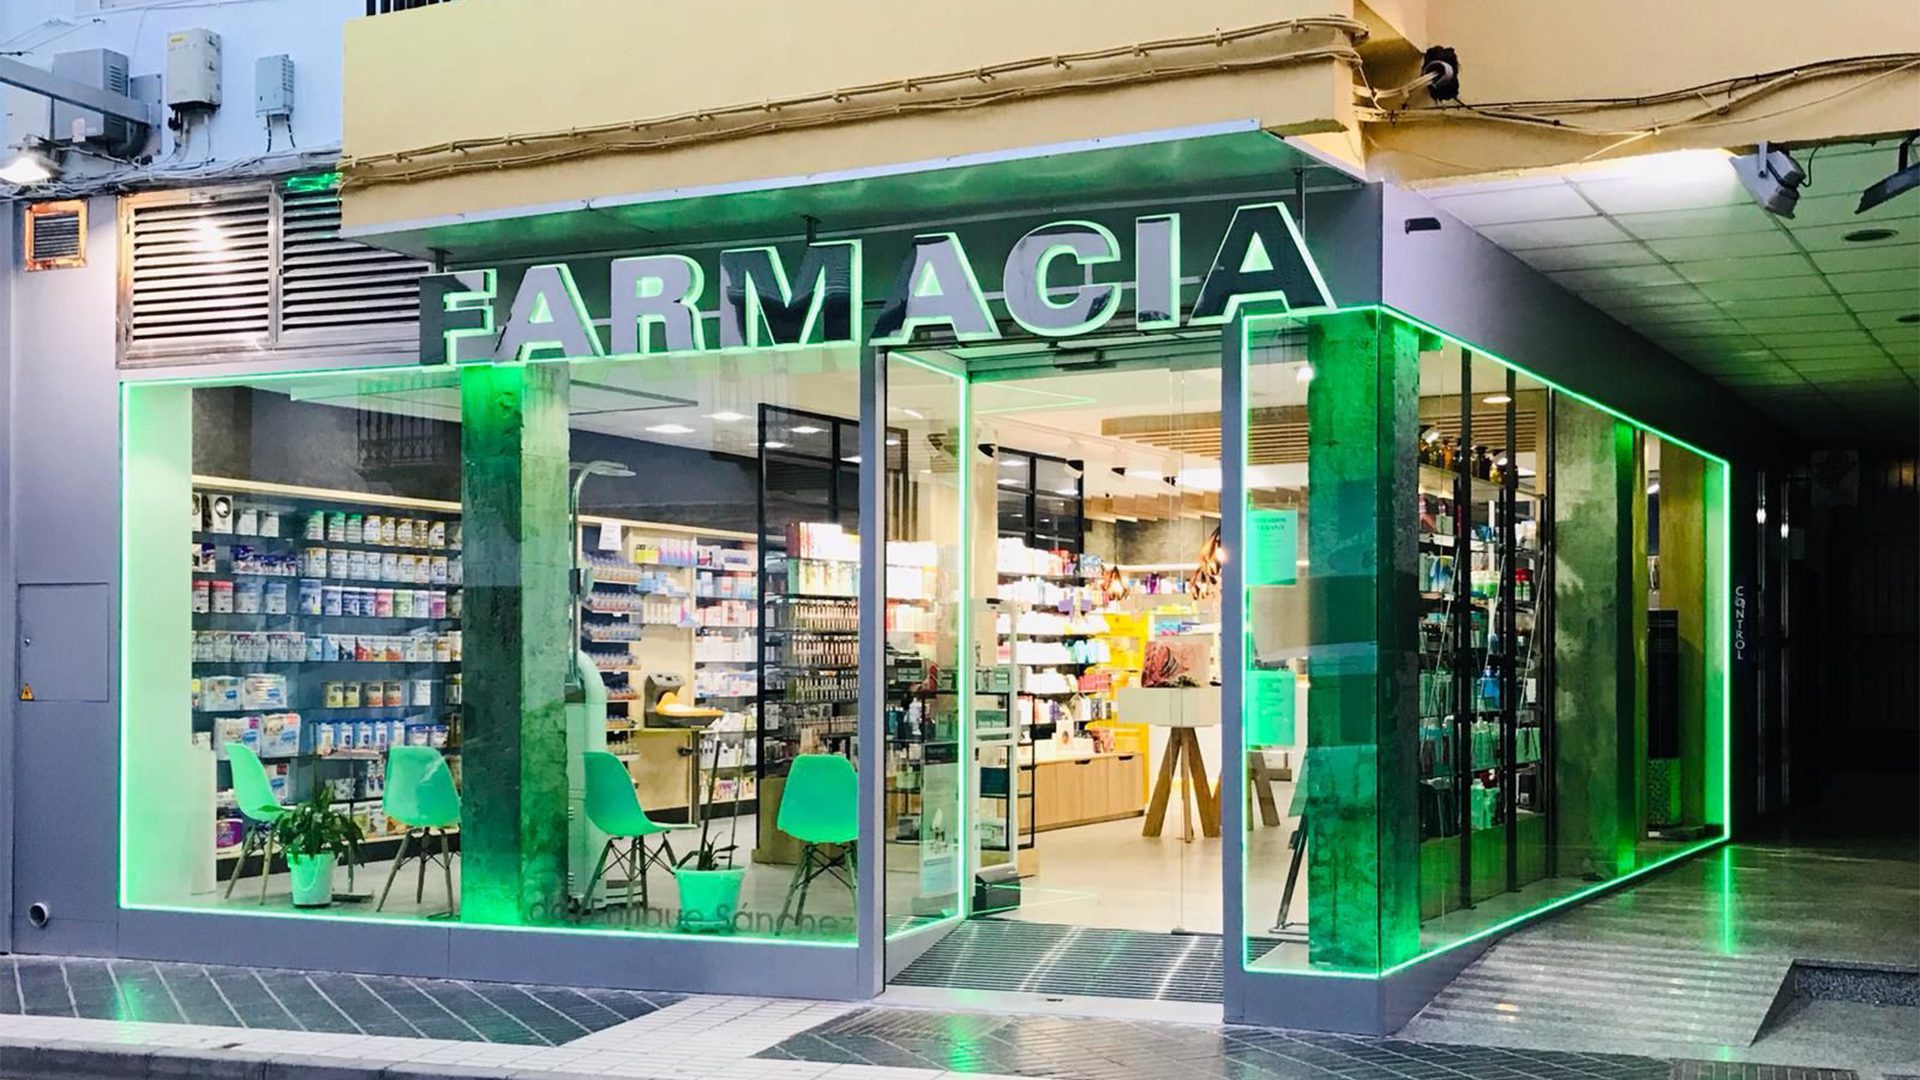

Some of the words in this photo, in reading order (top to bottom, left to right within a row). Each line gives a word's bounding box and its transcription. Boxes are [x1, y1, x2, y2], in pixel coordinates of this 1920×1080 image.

[419, 201, 1337, 370] FARMACIA
[1735, 586, 1745, 660] CONTROL
[716, 902, 854, 936] Sánchez
